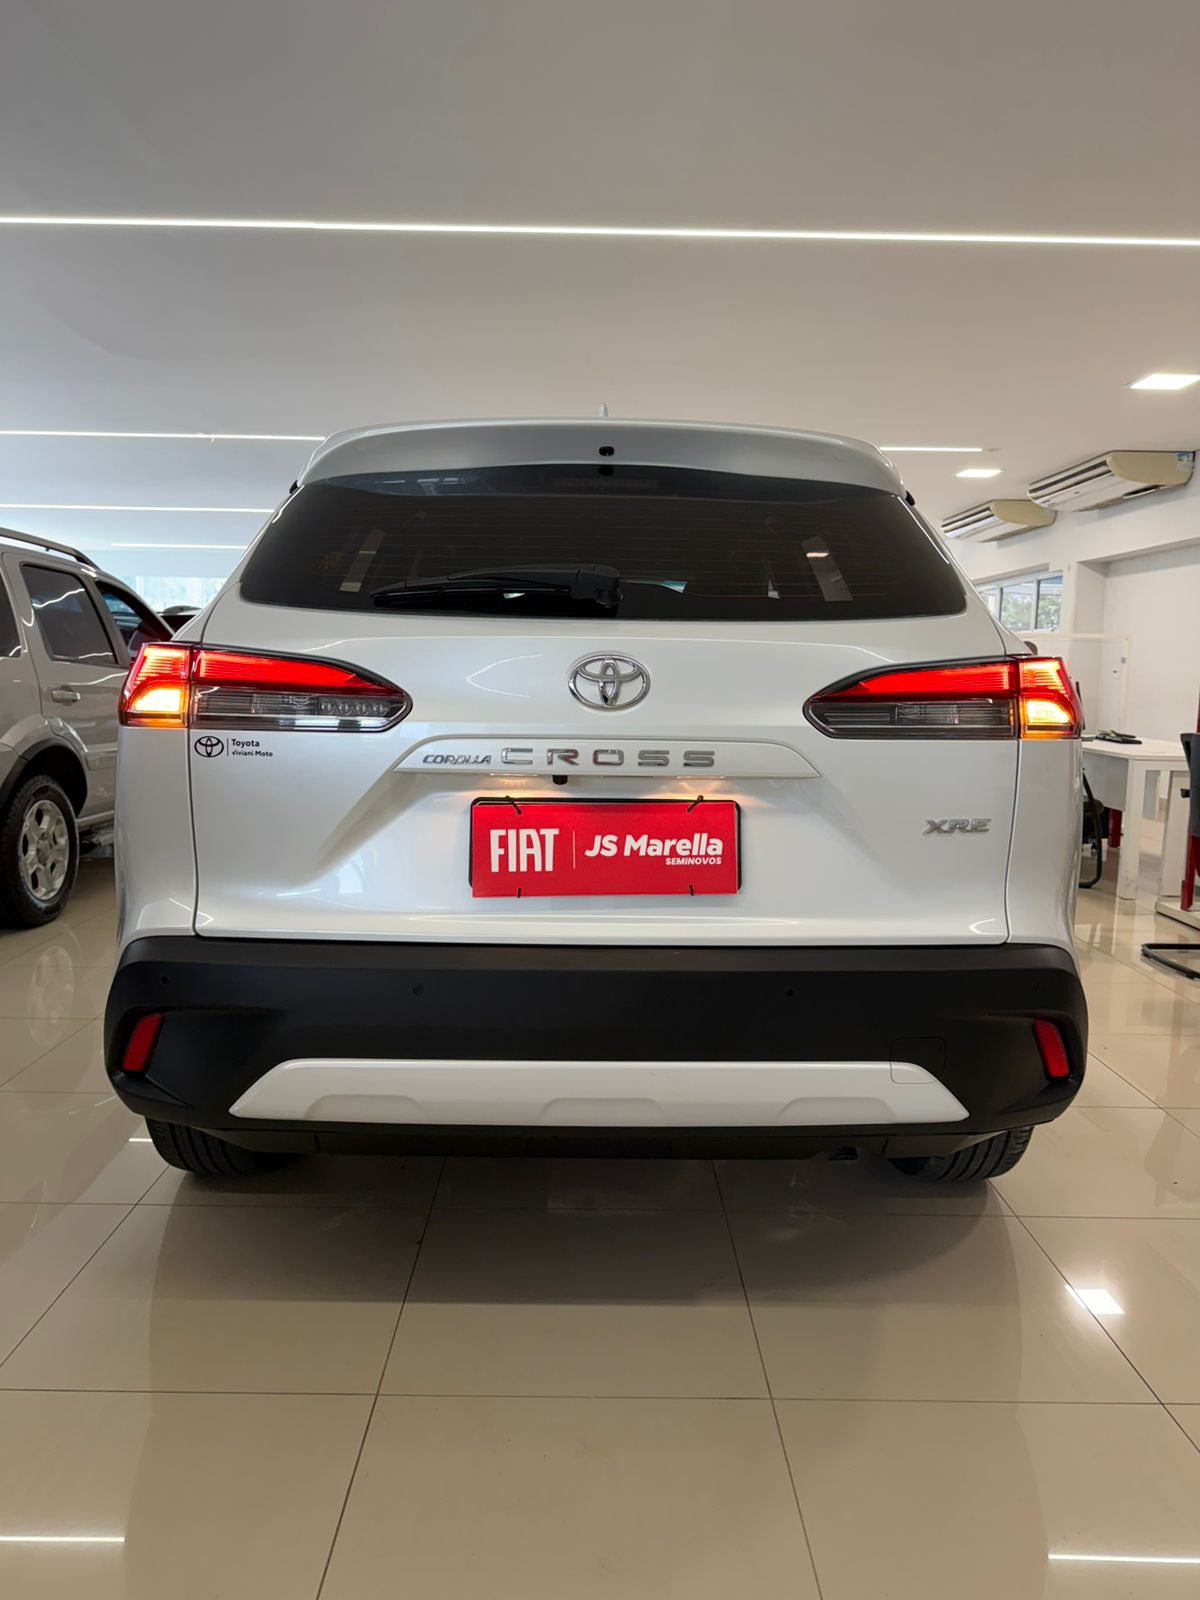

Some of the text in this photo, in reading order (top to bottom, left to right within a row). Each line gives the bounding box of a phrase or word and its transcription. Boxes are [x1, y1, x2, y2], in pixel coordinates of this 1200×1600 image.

[231, 738, 260, 748] Toyota
[422, 747, 716, 768] COROLLA CROSS
[923, 818, 992, 835] XRE
[490, 828, 560, 873] FIAT
[584, 833, 724, 857] JS Marella
[665, 857, 723, 866] SEMINOVOS
